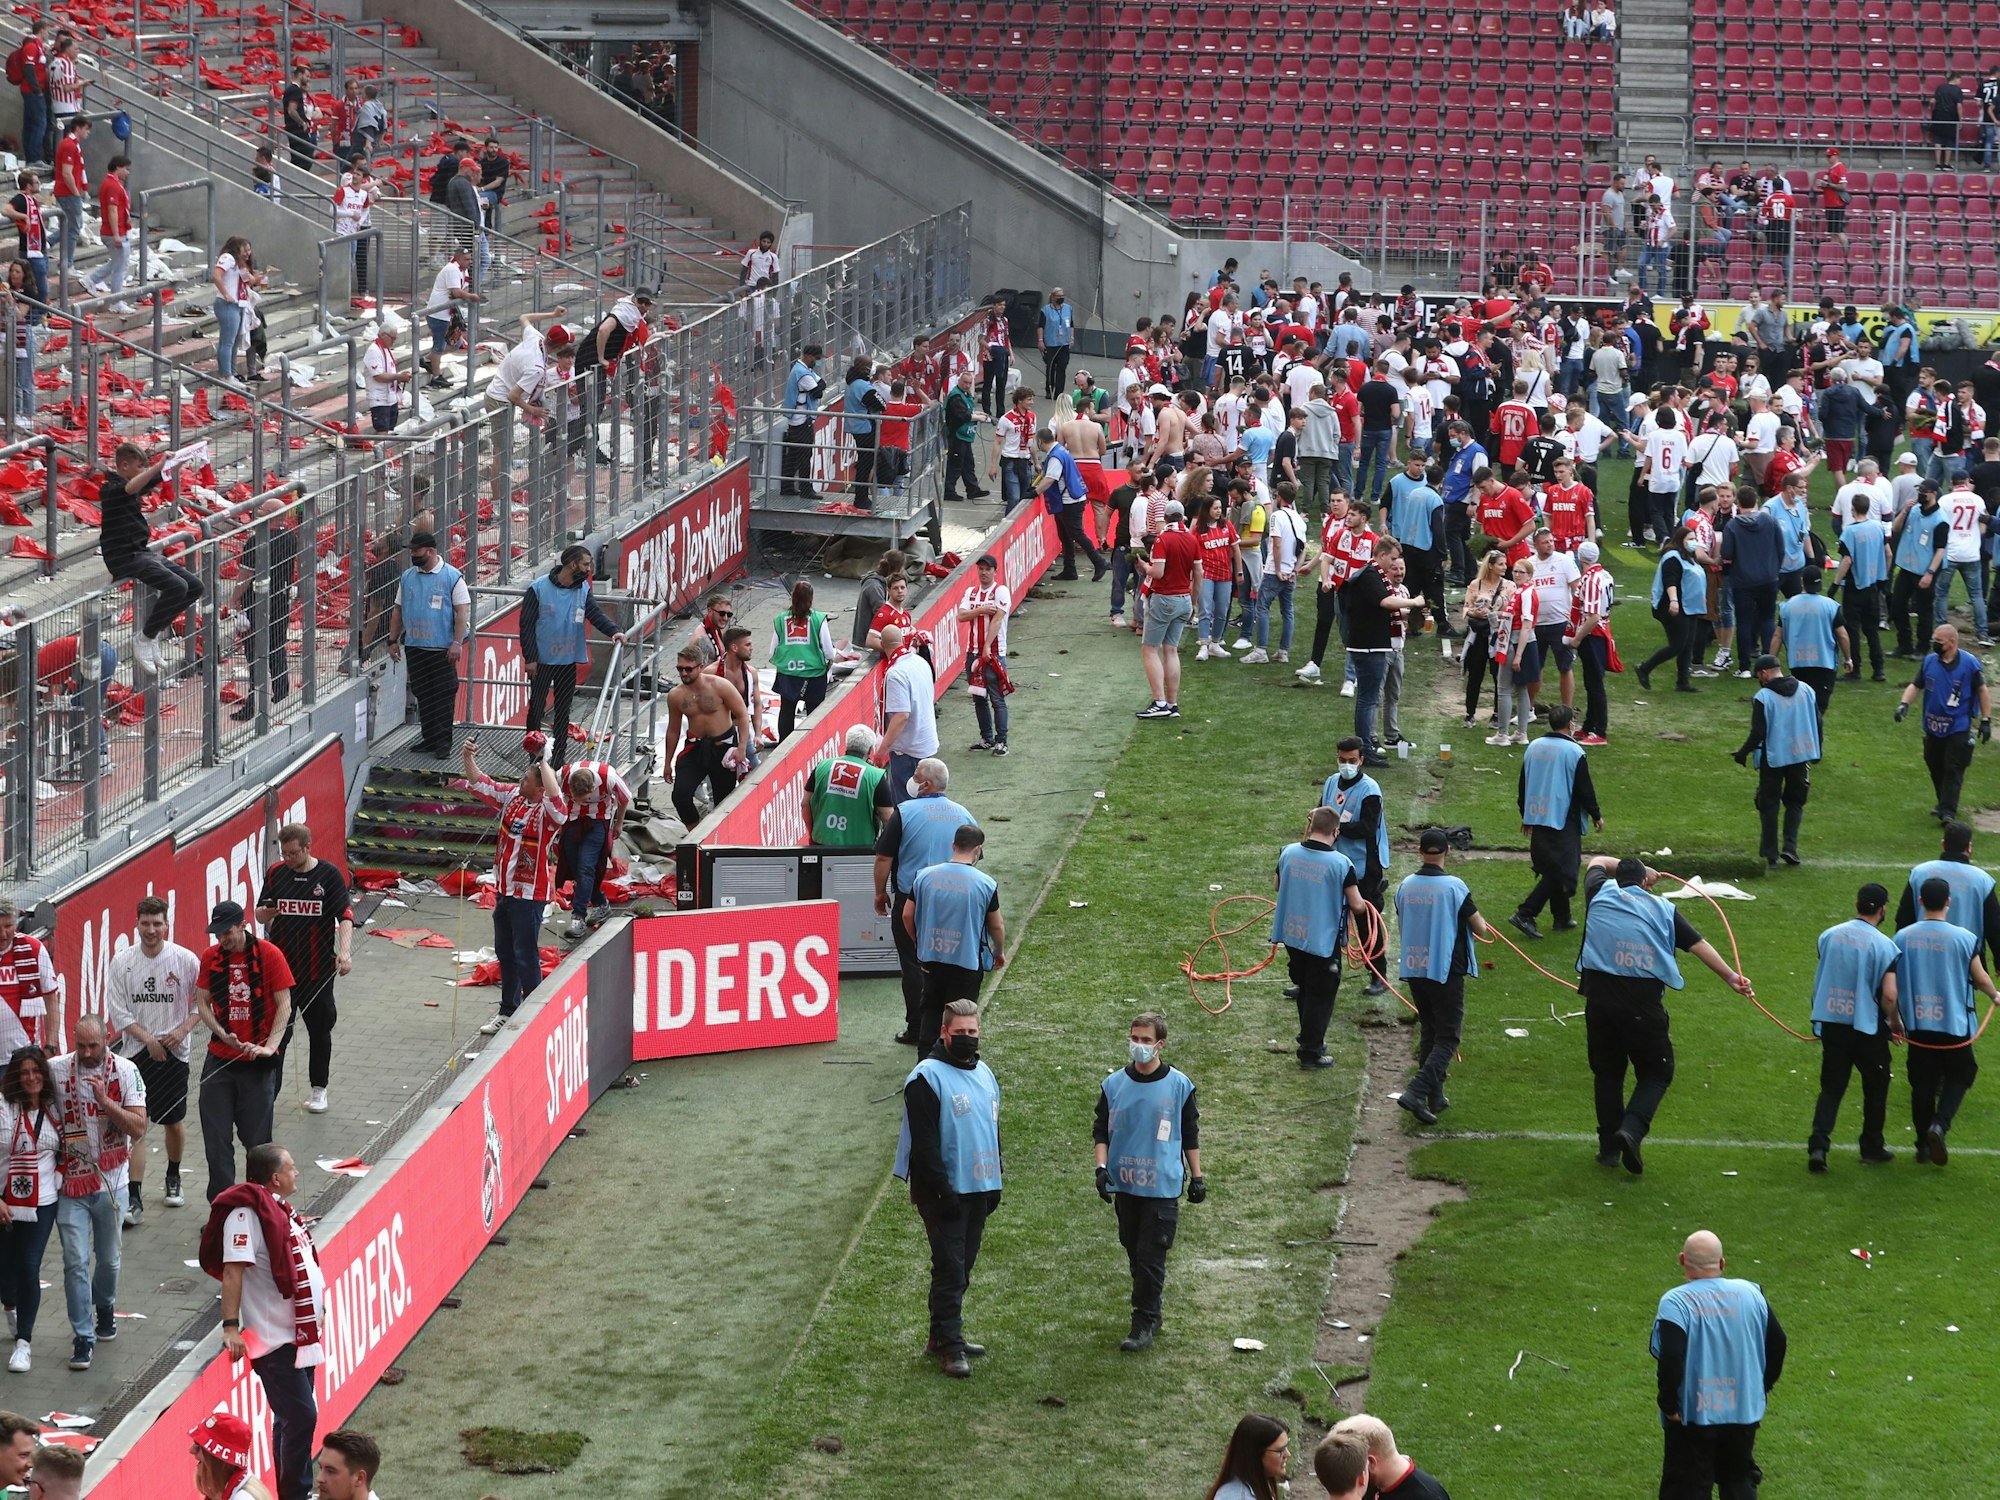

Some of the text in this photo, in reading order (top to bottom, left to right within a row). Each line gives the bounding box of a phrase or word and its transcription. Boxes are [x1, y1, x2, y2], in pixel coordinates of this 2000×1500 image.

[1773, 202, 1785, 218] 10
[1226, 355, 1244, 375] 14
[1420, 398, 1431, 421] 14
[1503, 414, 1525, 436] 10
[1662, 447, 1671, 469] 6
[1484, 508, 1503, 518] REWE
[1552, 502, 1576, 512] REWE
[1952, 505, 1976, 530] 27
[1204, 537, 1230, 550] REWE
[1532, 576, 1556, 586] EWE
[787, 659, 806, 671] 05
[483, 638, 520, 726] Dein
[829, 785, 856, 796] BUNDESLIGA
[924, 803, 960, 814] SECURIT
[826, 813, 848, 831] 08
[278, 900, 321, 915] REWE
[1615, 940, 1655, 953] STEWARD
[1615, 951, 1654, 970] 0613
[131, 993, 174, 1004] SAMSUNG
[1119, 1156, 1157, 1167] STEWARD
